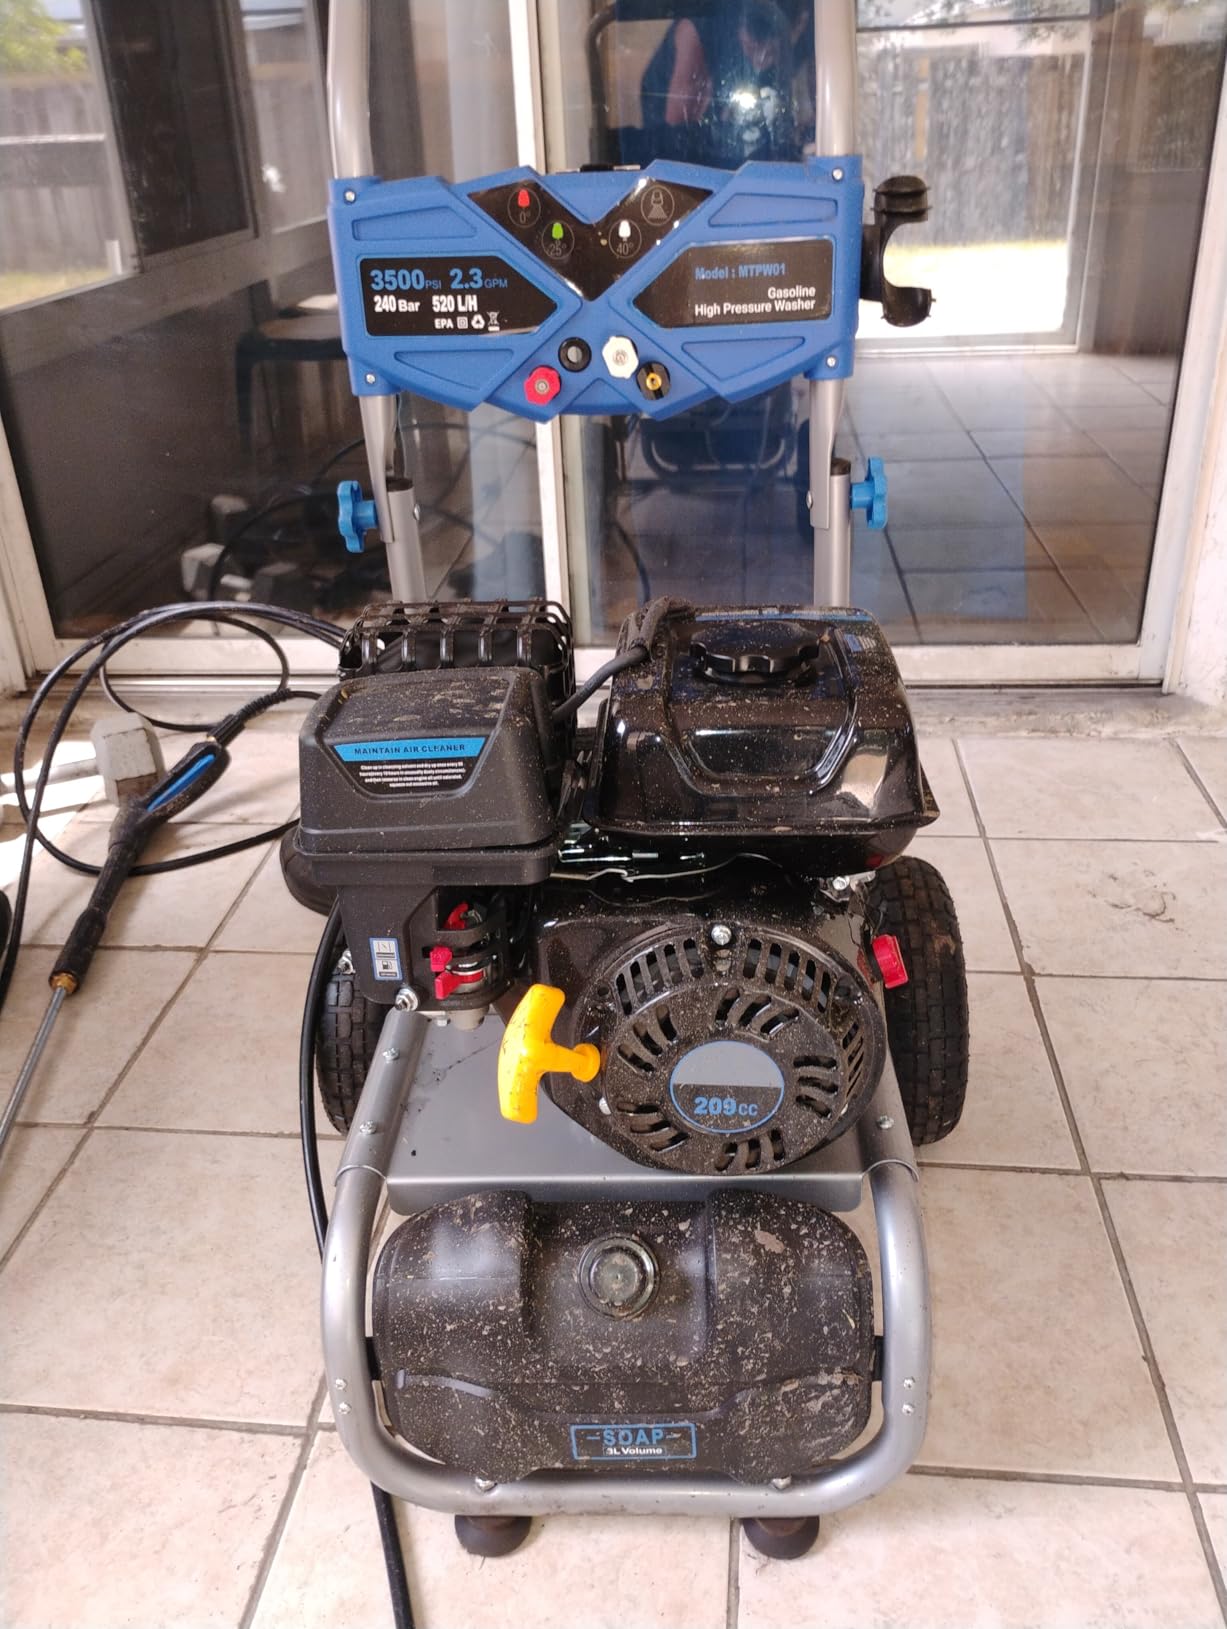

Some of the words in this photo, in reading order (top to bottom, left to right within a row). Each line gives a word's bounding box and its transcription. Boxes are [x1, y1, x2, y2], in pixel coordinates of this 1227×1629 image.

[695, 265, 729, 280] Model
[738, 263, 786, 278] MTPW01
[768, 285, 816, 299] Gasoline
[432, 295, 455, 312] 520
[457, 295, 478, 312] L/H
[695, 303, 721, 318] High
[723, 300, 772, 315] Pressure
[774, 298, 816, 312] Washer
[434, 318, 454, 329] EPA
[354, 747, 401, 755] MAINTAIN
[403, 746, 420, 754] AIR
[421, 744, 466, 753] CLEANER
[603, 1428, 664, 1446] SOAP
[606, 1447, 620, 1455] 3L
[621, 1447, 663, 1455] Volume
